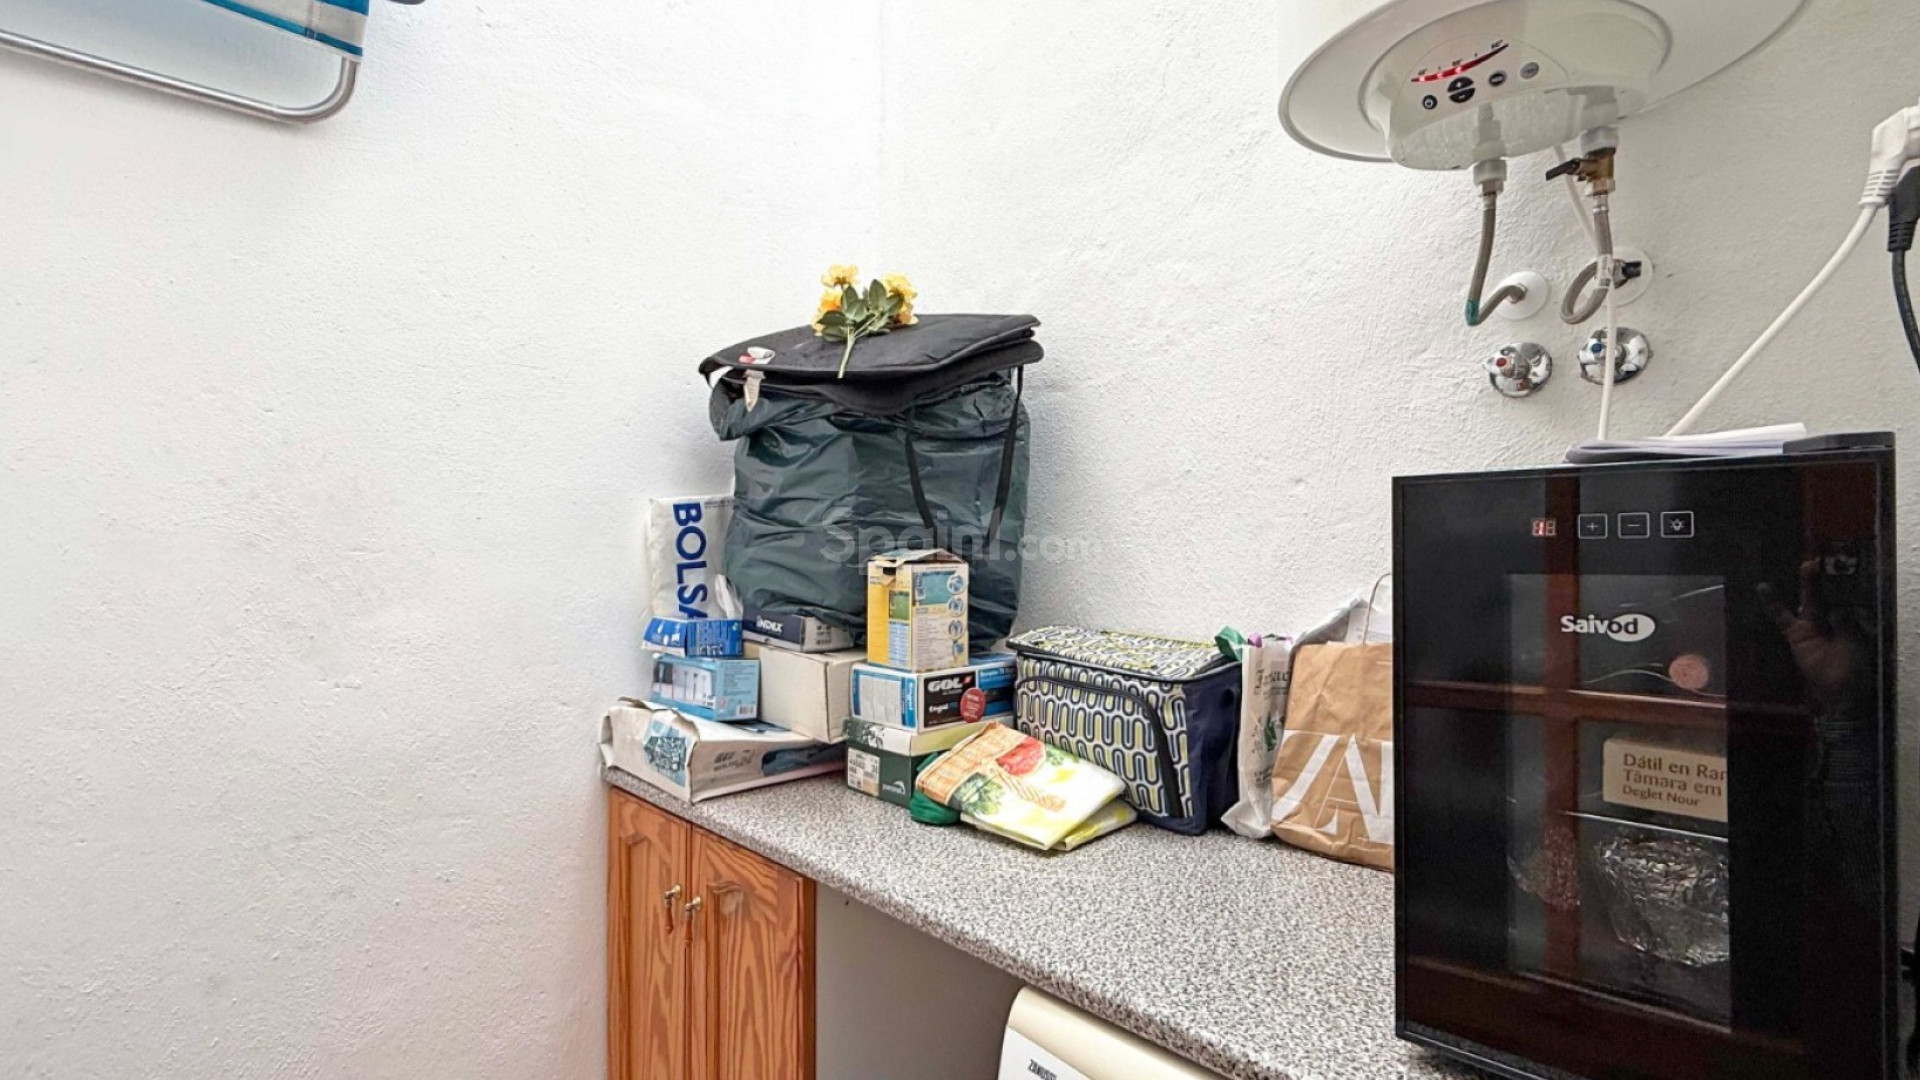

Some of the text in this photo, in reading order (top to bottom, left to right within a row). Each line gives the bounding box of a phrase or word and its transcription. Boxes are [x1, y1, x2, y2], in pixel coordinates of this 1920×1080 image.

[1560, 613, 1639, 635] Saivod
[1623, 753, 1663, 771] Dátil
[1668, 762, 1690, 776] en
[1622, 784, 1702, 806] Deglet Nour
[1694, 782, 1722, 797] em
